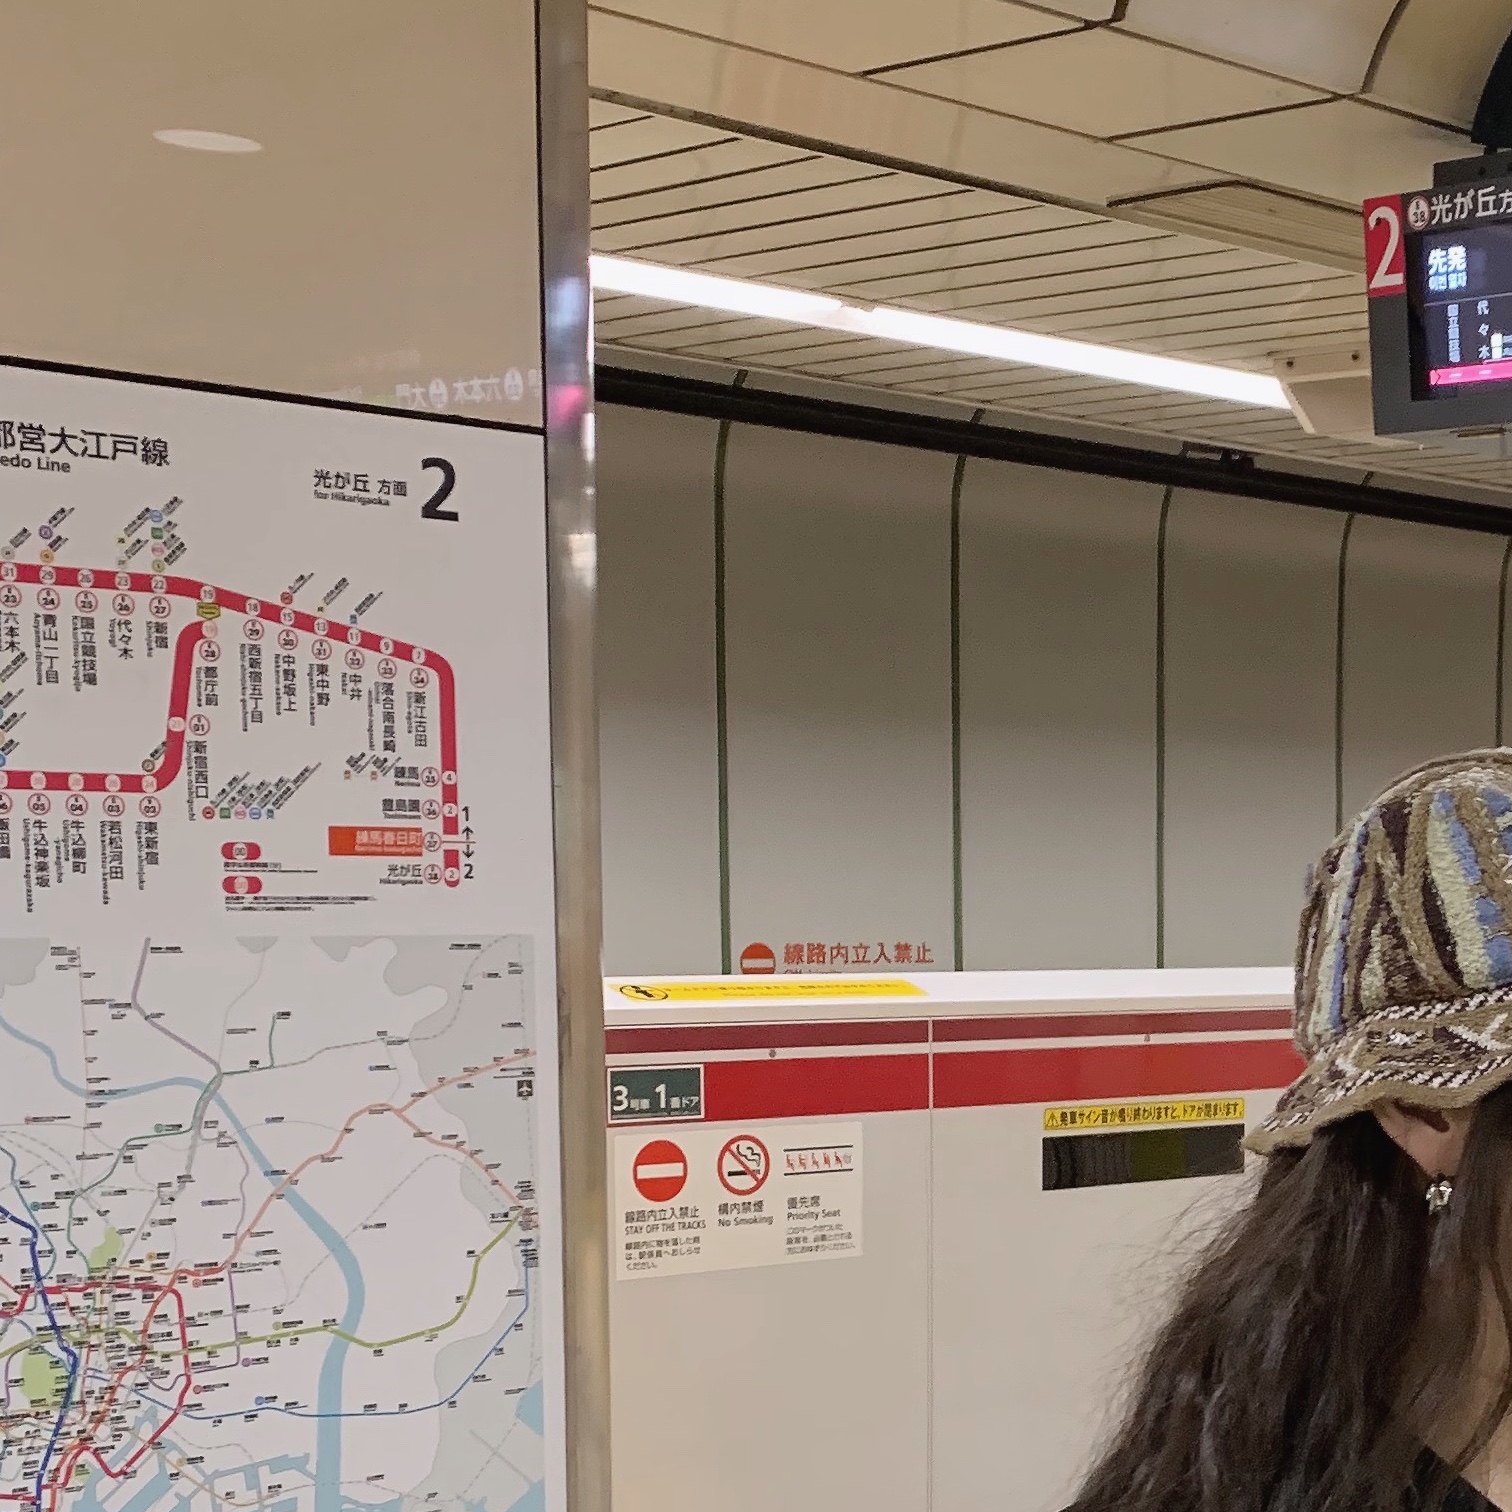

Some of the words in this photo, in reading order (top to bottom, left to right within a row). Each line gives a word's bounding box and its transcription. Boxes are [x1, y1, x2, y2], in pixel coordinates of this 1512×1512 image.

[1413, 211, 1425, 223] 38
[1368, 206, 1403, 288] 2
[1428, 245, 1467, 273] 先発
[37, 457, 71, 473] Line
[313, 468, 370, 492] 光が丘
[421, 457, 459, 522] 2
[4, 612, 20, 653] 六本木
[117, 618, 133, 660] 代々木
[43, 614, 59, 684] 青山一丁目
[282, 654, 297, 712] 中野坂上
[316, 663, 330, 706] 東中野
[350, 673, 363, 700] 中井
[414, 691, 428, 747] 新江古田
[462, 806, 469, 822] 1
[387, 864, 421, 877] 光が丘
[464, 863, 474, 879] 2
[784, 941, 934, 965] 線路内立入禁止
[625, 1207, 699, 1223] 線路内立入禁止
[718, 1200, 764, 1215] 構内禁煙
[787, 1209, 819, 1222] Priority
[822, 1208, 841, 1218] Seat
[625, 1225, 643, 1235] STAY
[646, 1223, 660, 1233] OFF
[661, 1222, 675, 1232] THE
[678, 1220, 706, 1231] TRACKS
[718, 1217, 731, 1227] No
[734, 1215, 774, 1227] Smoking
